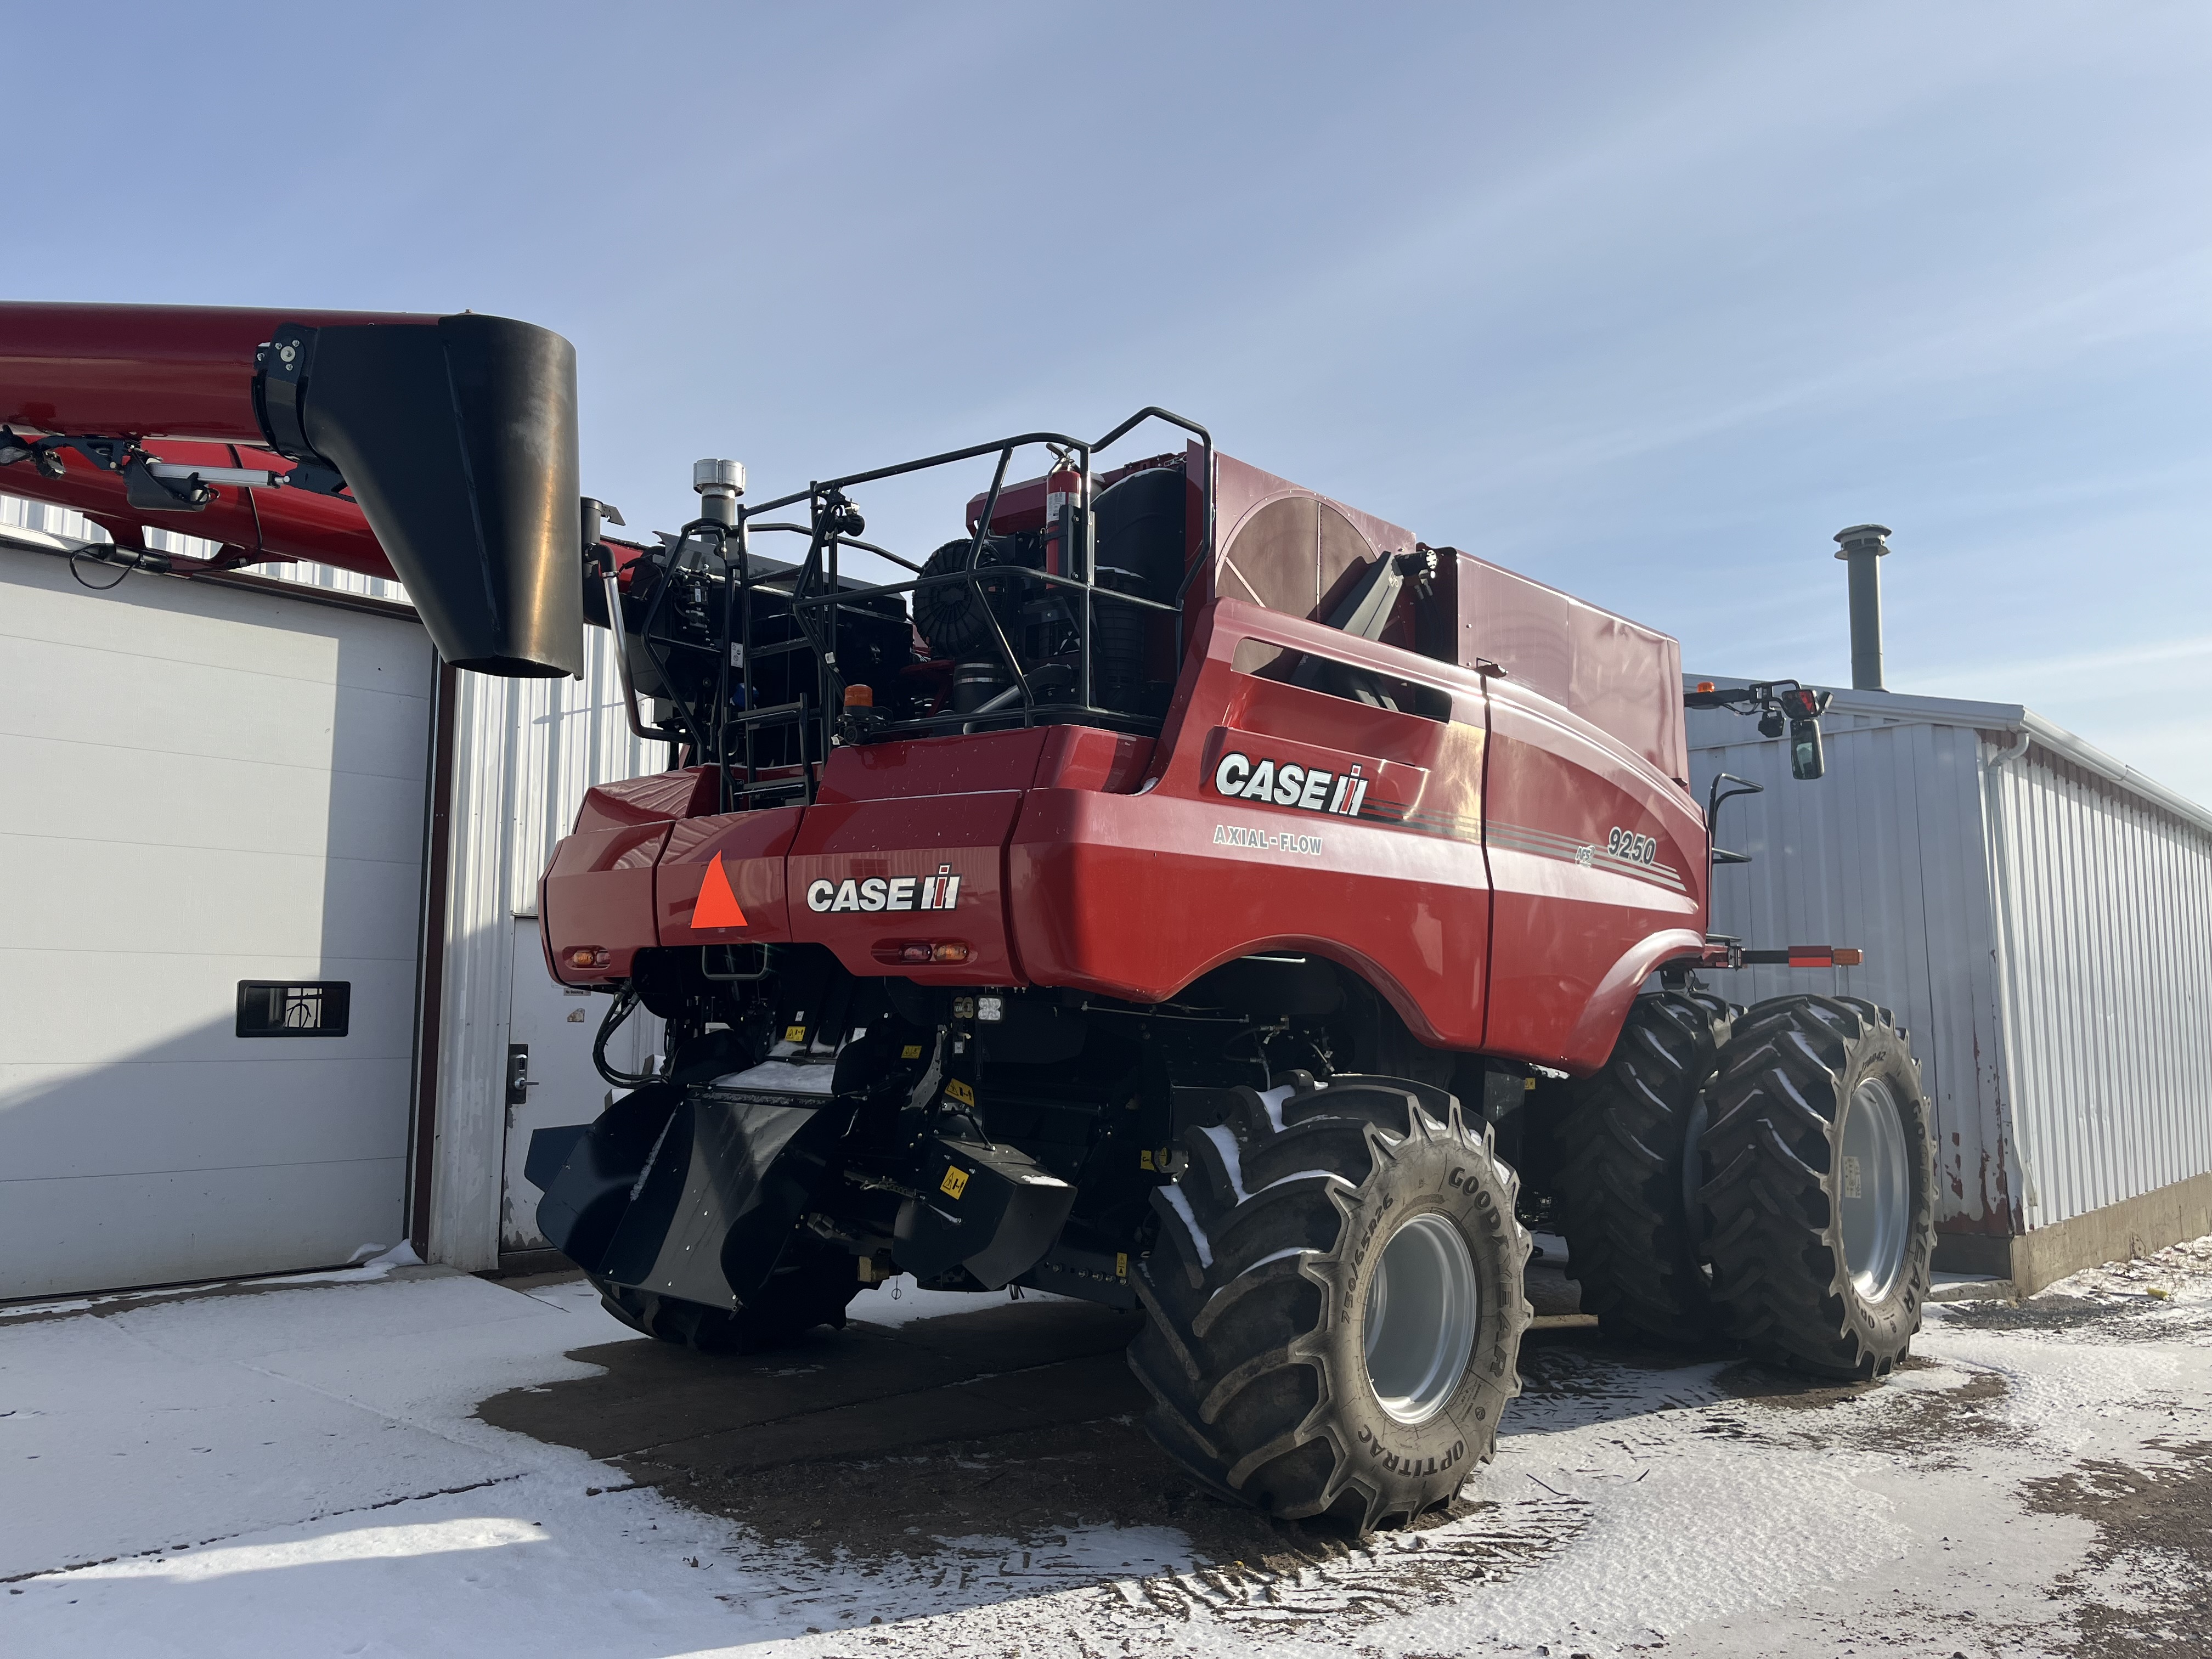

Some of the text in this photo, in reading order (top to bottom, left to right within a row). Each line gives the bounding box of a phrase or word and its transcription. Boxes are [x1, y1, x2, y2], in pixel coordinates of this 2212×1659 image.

[1216, 753, 1333, 810] CASE
[1213, 824, 1323, 855] AXIAL-FLOW
[1575, 846, 1592, 862] AFS
[1607, 826, 1656, 866] 9250
[806, 877, 916, 912] CASE
[1341, 1192, 1393, 1324] 750/65R26
[1448, 1166, 1513, 1378] GOODYEAR
[1358, 1424, 1464, 1479] OPTITRAC
